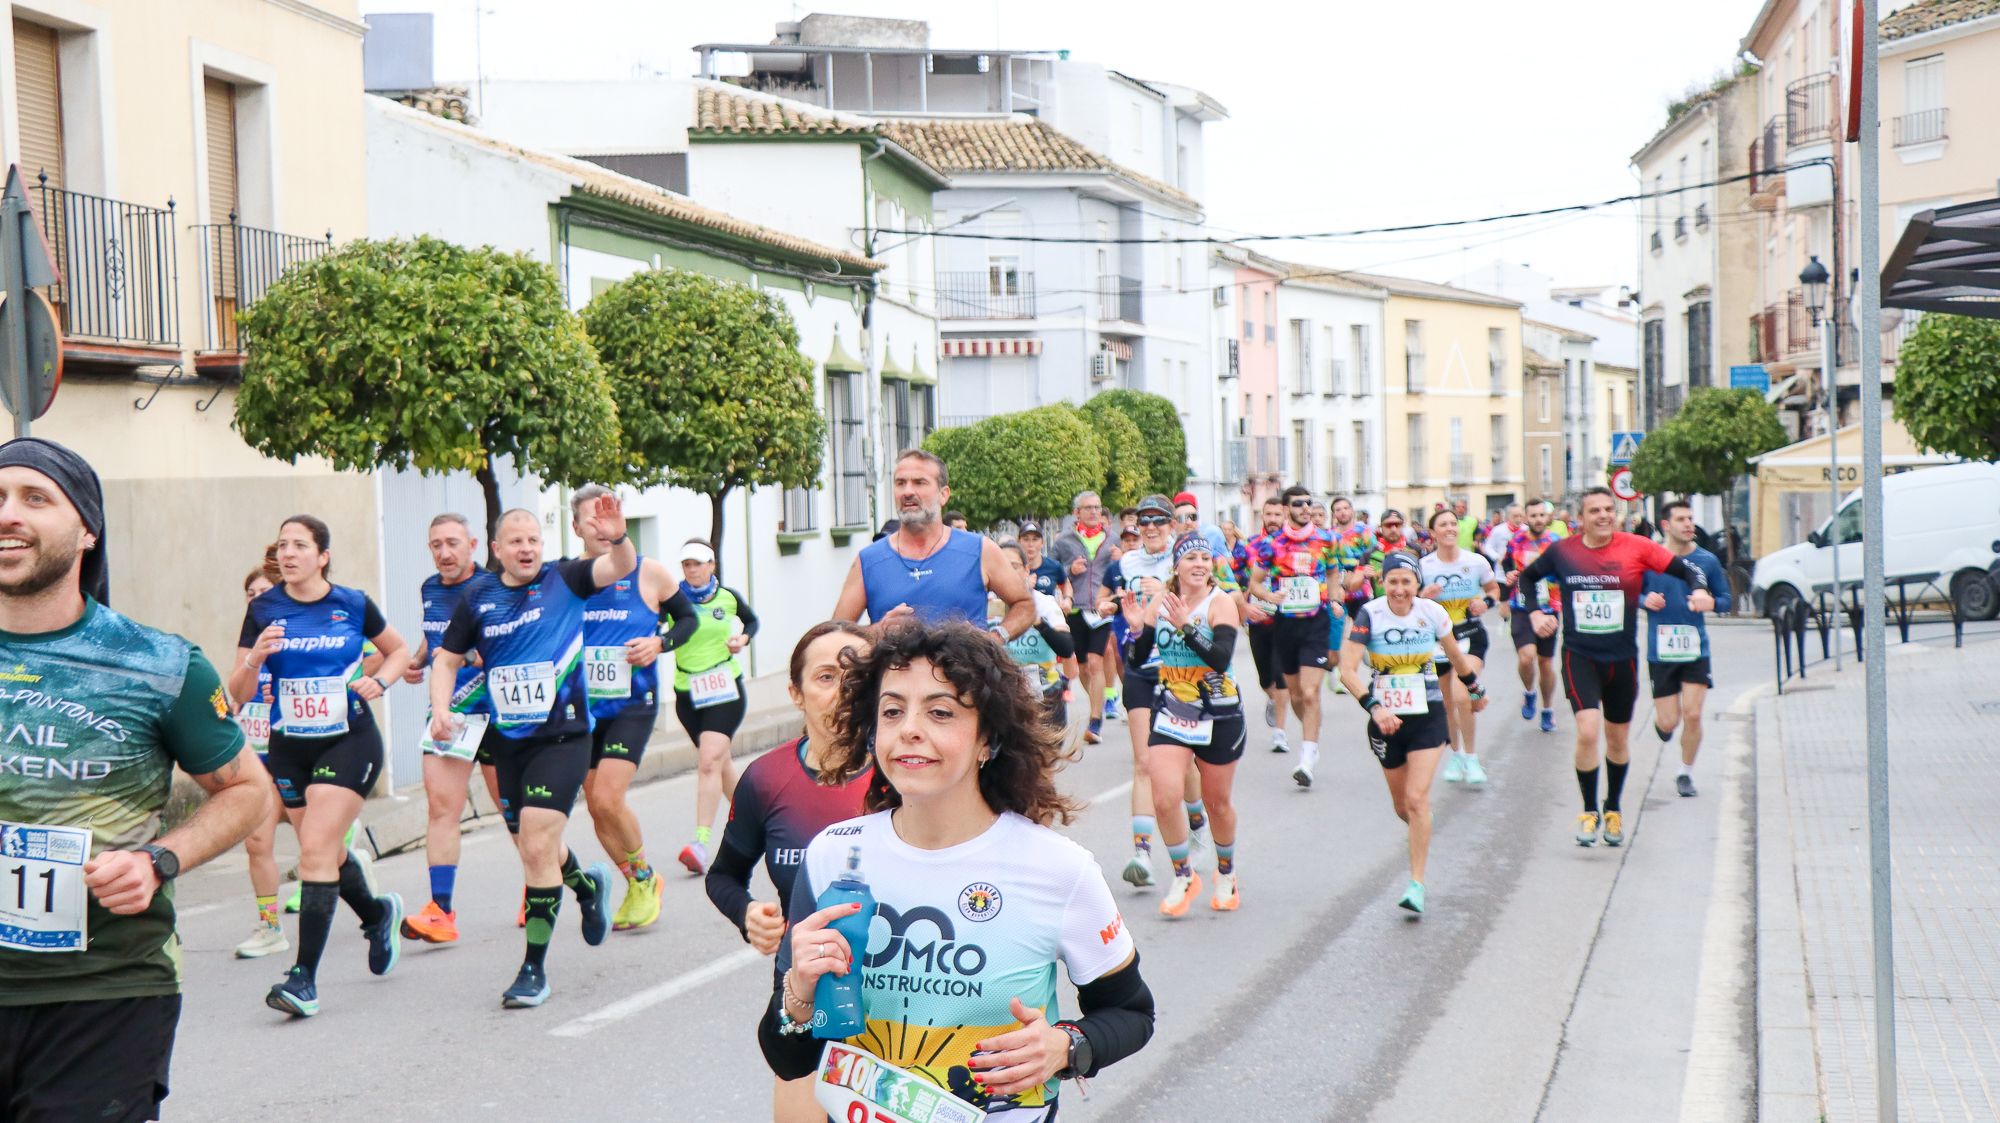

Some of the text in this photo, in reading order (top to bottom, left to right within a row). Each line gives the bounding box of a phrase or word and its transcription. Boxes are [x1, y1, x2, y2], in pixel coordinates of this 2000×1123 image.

[1822, 467, 1857, 481] RCO
[583, 609, 629, 622] nerplus
[1586, 604, 1611, 619] 840
[1667, 635, 1690, 649] 410
[588, 662, 616, 681] 786
[500, 682, 545, 705] 1414
[692, 672, 727, 694] 1186
[293, 697, 328, 719] 564
[1383, 690, 1413, 708] 534
[0, 723, 69, 748] AIL
[11, 865, 55, 913] 11
[860, 973, 983, 998] NSTRUCCION
[837, 1053, 884, 1101] 10K
